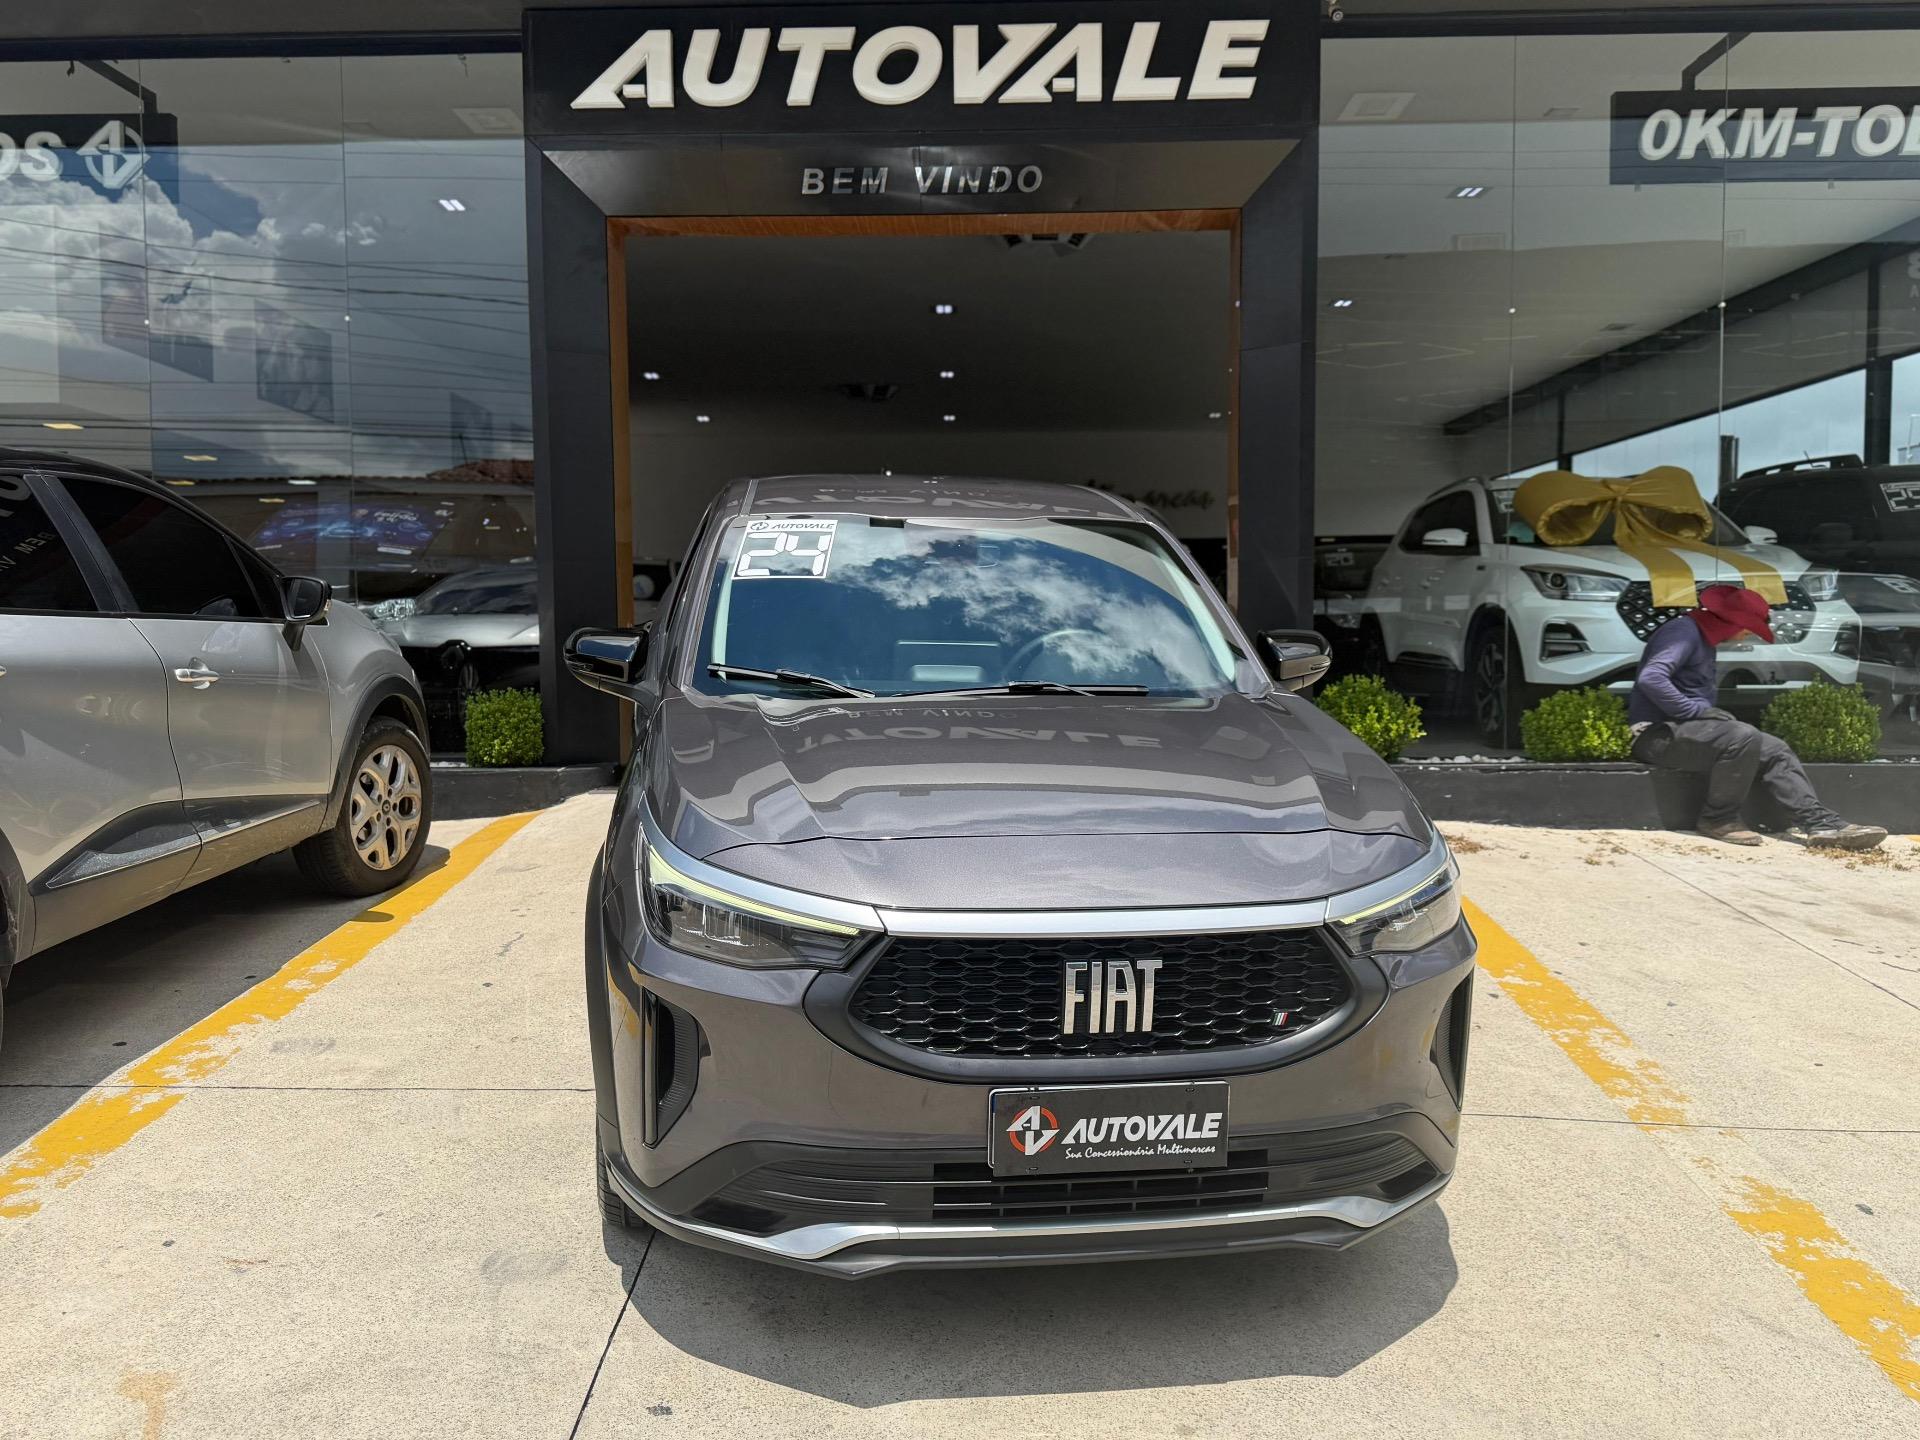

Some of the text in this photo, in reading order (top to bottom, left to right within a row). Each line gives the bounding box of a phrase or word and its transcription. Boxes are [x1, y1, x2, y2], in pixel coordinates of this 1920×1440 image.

[570, 19, 1271, 110] AUTOVALE
[801, 165, 1043, 196] BEM VINDO
[737, 531, 832, 576] 24
[1063, 959, 1163, 1035] FIAT
[1061, 1112, 1223, 1145] AUTOVALE
[1065, 1143, 1216, 1160] Sua Concessionária Multimarcas
